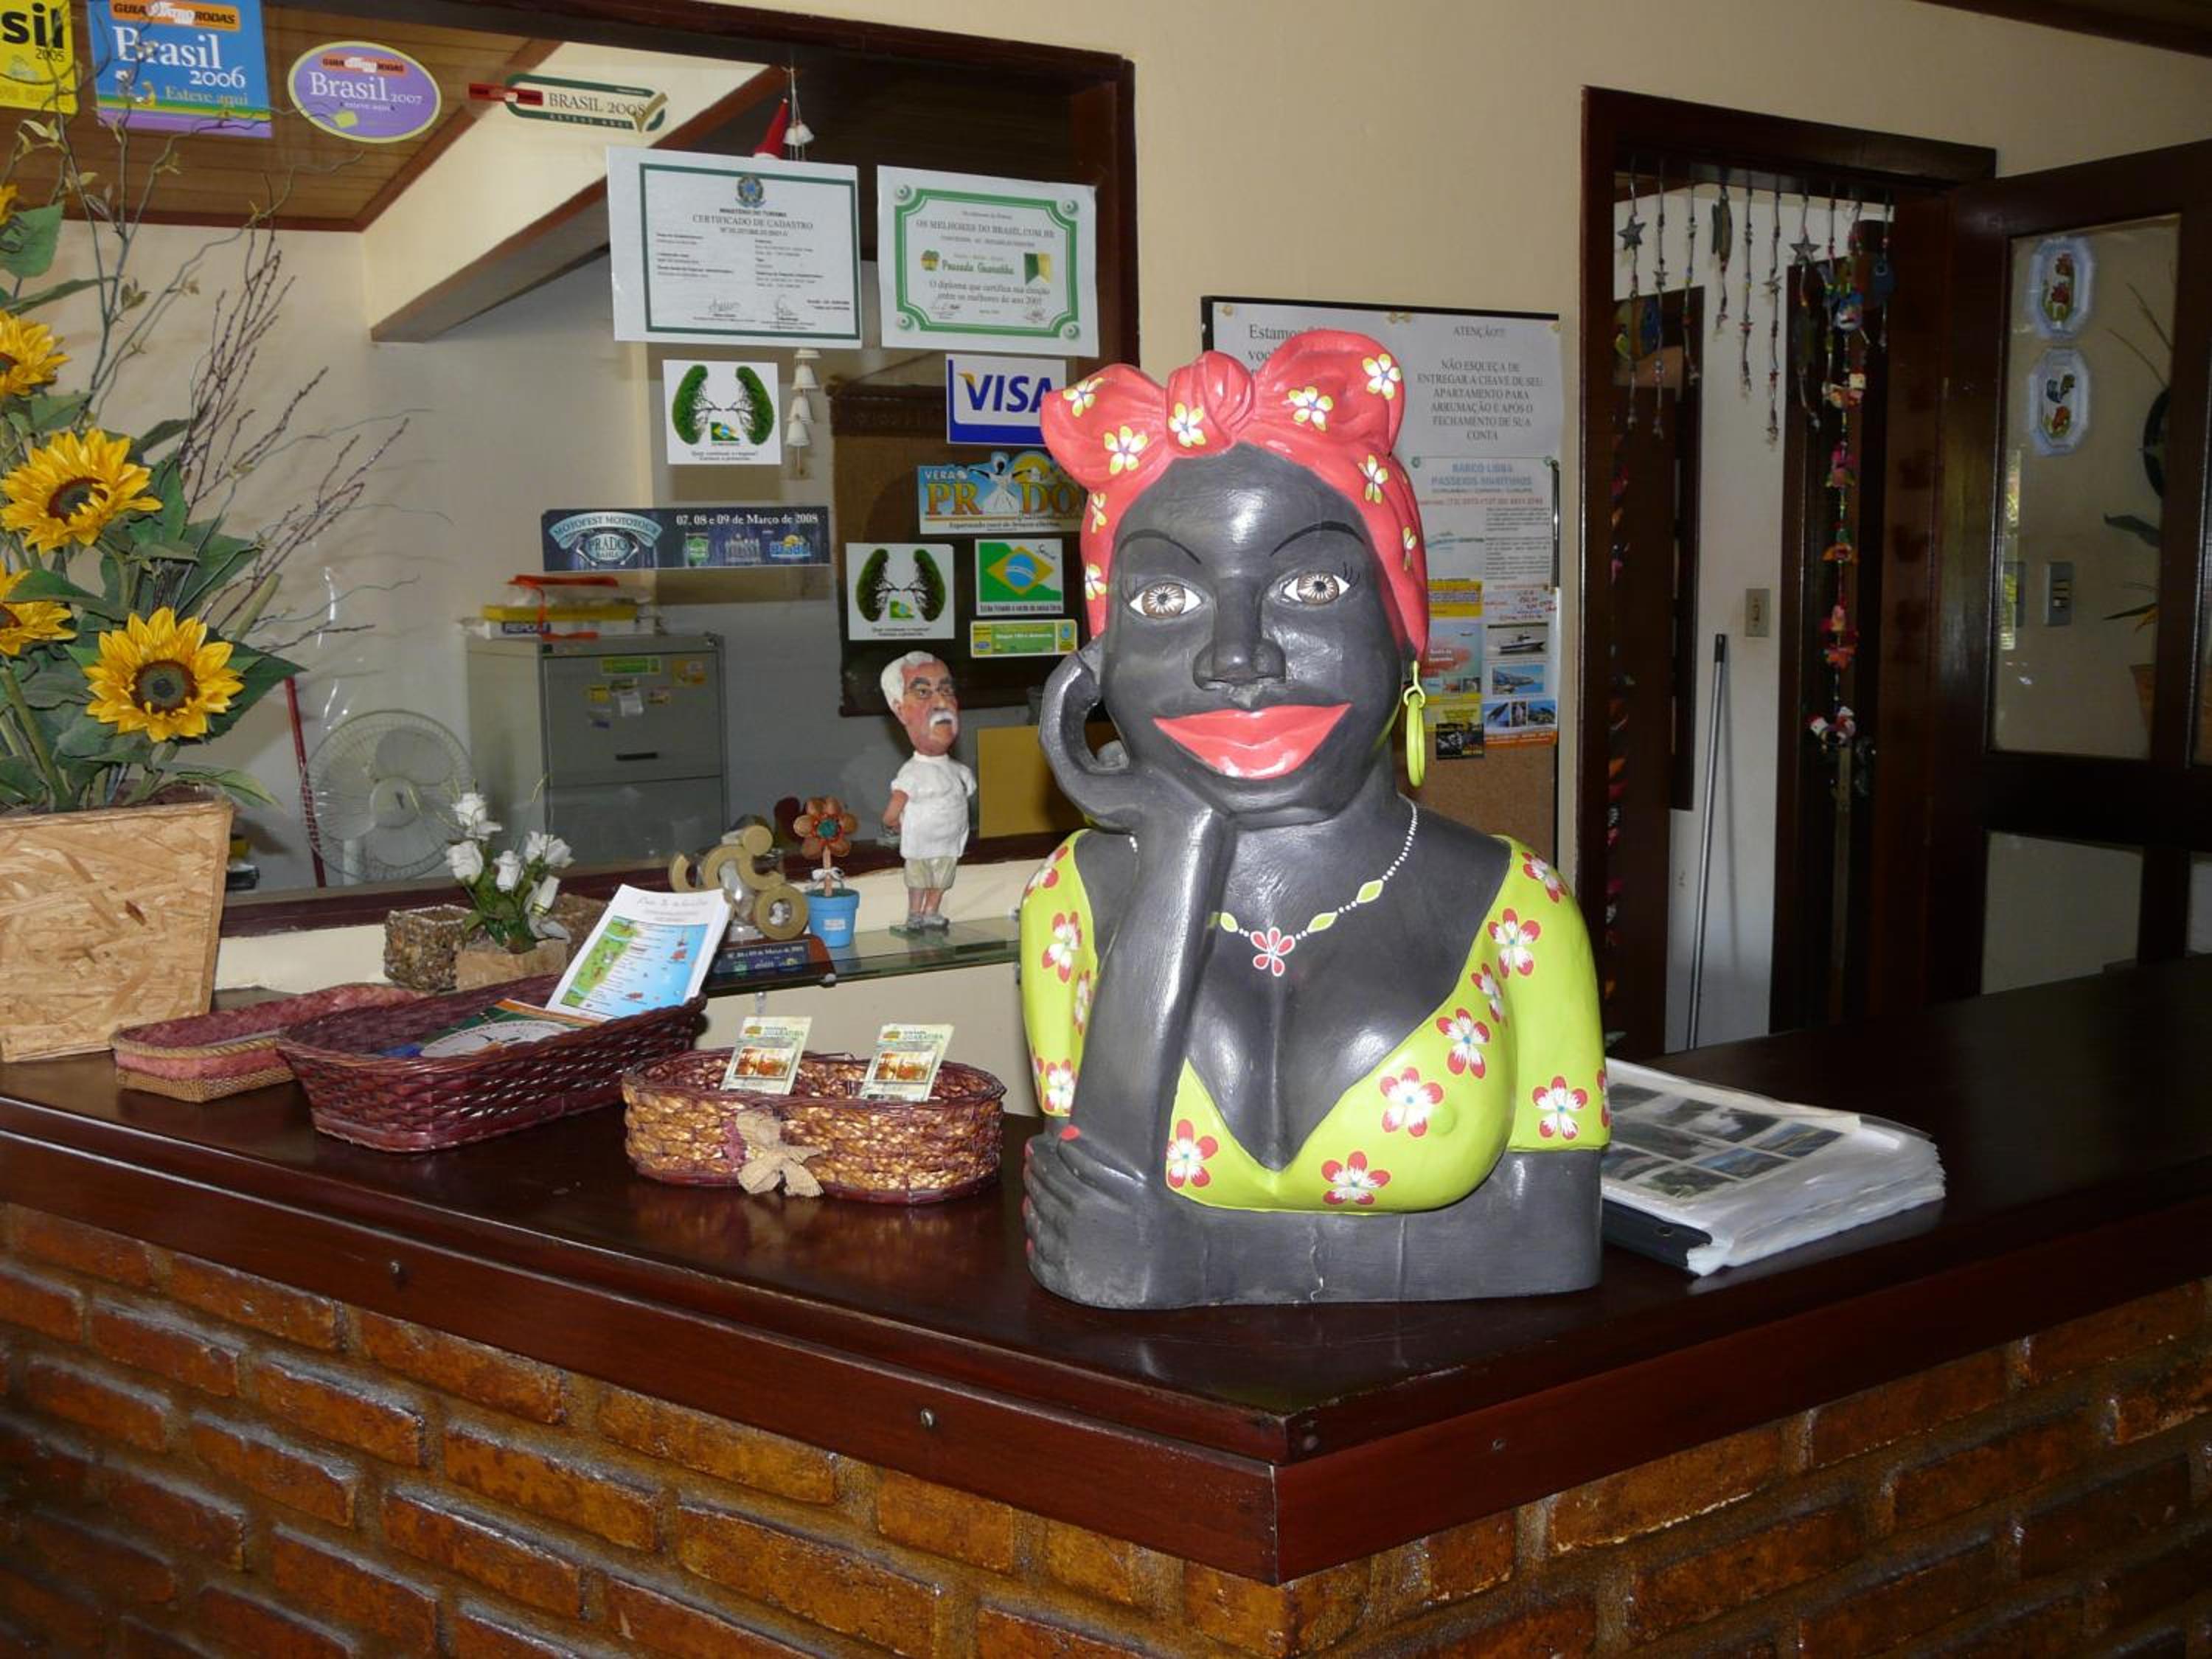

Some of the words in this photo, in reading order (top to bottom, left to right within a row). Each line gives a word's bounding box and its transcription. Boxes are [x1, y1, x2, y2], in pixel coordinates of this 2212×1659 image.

[114, 1, 147, 15] GUIA
[194, 10, 235, 25] RODAS
[112, 25, 223, 69] Brasil
[189, 65, 246, 88] 2006
[164, 84, 213, 104] Esteve
[216, 91, 248, 108] aqui
[308, 71, 389, 102] Brasil
[390, 92, 423, 105] 2007
[548, 92, 603, 112] BRASIL
[692, 214, 751, 226] CERTIFICADO
[753, 218, 764, 226] DE
[766, 219, 813, 230] CADASTRO
[1249, 323, 1302, 340] Estamo
[1441, 358, 1462, 370] NÃO
[1417, 373, 1467, 385] ENTREGAR
[1470, 375, 1478, 385] A
[1478, 375, 1509, 386] CHAVE
[961, 374, 1054, 413] VISA
[1433, 389, 1503, 400] APARTAMENTO
[1505, 389, 1530, 400] PARA
[1430, 401, 1492, 413] ARRUMAÇÃO
[1432, 416, 1497, 426] FECHAMENTO
[1498, 417, 1511, 426] DE
[1466, 430, 1498, 441] CONTA
[732, 515, 745, 524] de
[746, 514, 779, 525] Março
[781, 514, 793, 524] de
